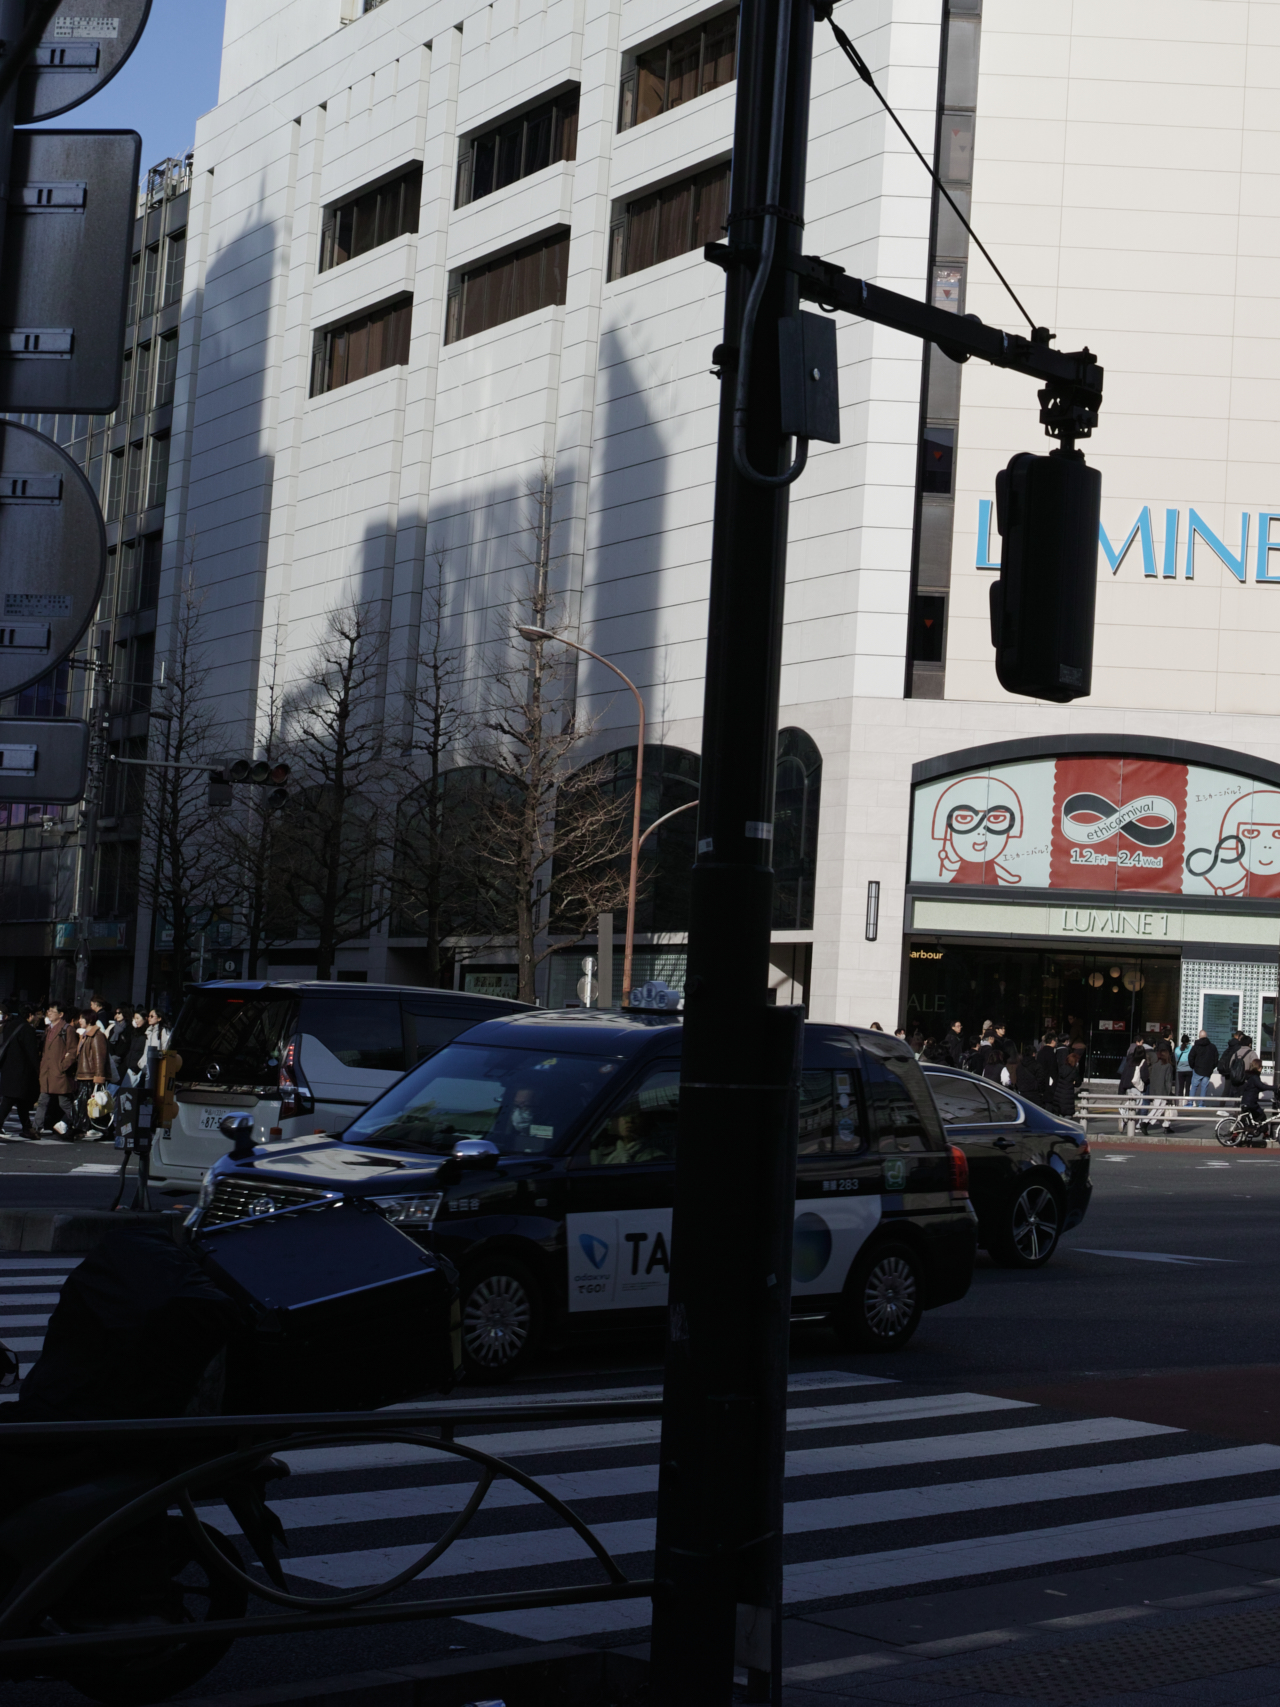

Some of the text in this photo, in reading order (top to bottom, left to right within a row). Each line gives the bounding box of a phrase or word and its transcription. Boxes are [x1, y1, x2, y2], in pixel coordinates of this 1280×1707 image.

[1086, 800, 1154, 840] ethicarnival
[1062, 908, 1169, 936] LUMINE 1
[838, 1179, 859, 1190] 283
